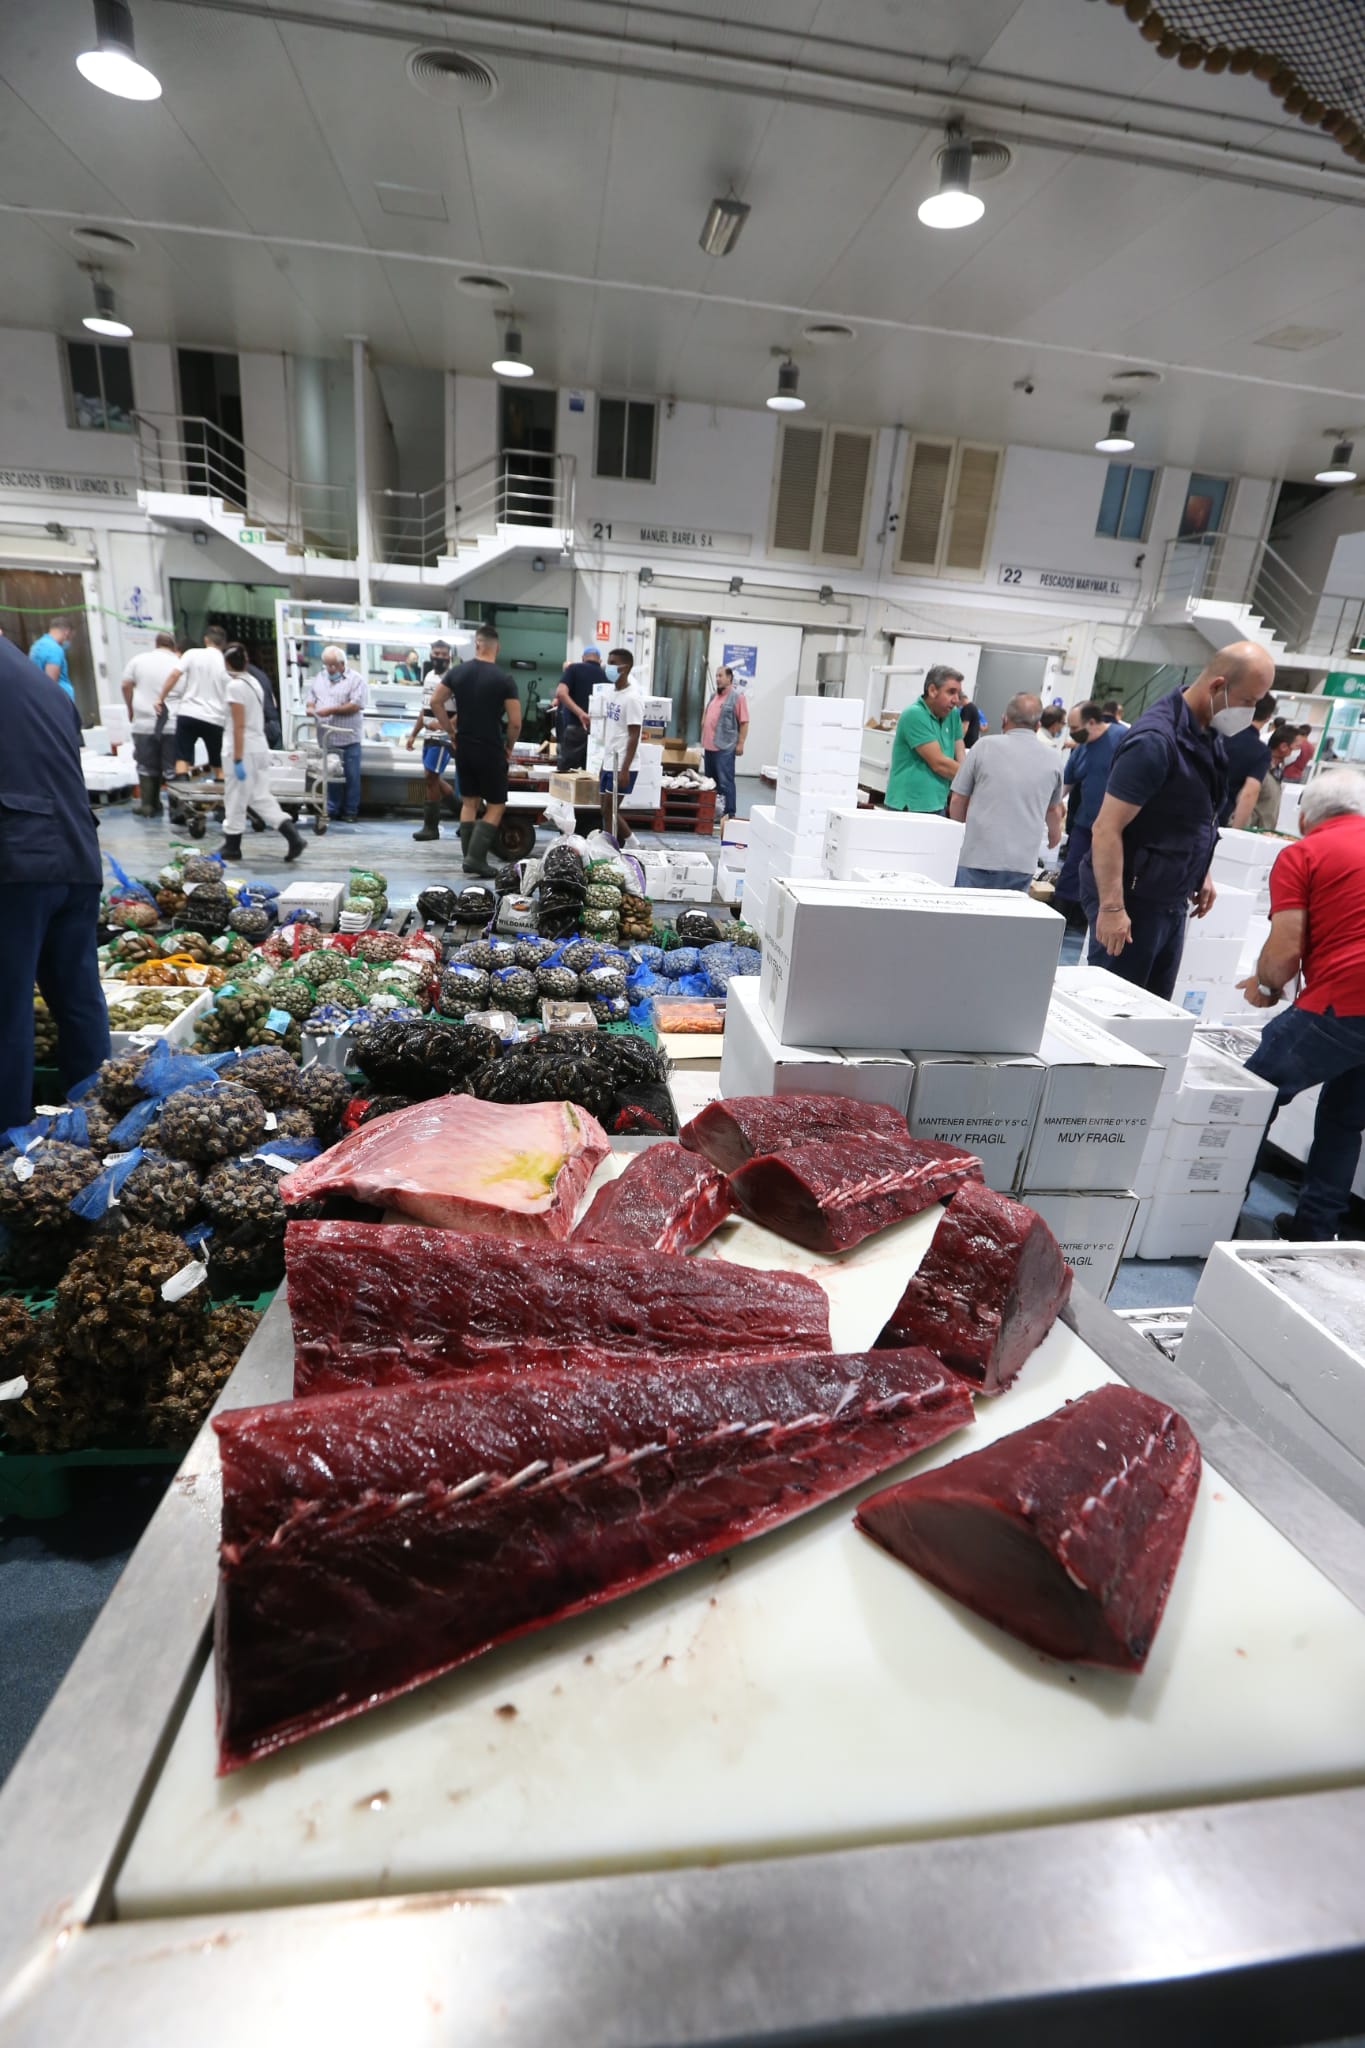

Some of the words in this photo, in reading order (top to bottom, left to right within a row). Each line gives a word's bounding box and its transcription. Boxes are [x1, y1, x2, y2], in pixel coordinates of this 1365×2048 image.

[593, 522, 612, 540] 21
[640, 528, 669, 543] MANUEL
[1003, 567, 1022, 584] 22
[1040, 573, 1075, 590] PESCADOS
[919, 1117, 964, 1126] MANTENER
[966, 1118, 993, 1127] ENTRE
[1005, 1119, 1011, 1127] Y
[1044, 1117, 1087, 1126] MANTENER
[1088, 1118, 1115, 1126] ENTRE
[934, 1133, 962, 1143] MUY
[964, 1133, 1007, 1144] FRAGIL
[1057, 1132, 1085, 1143] MUY
[1086, 1132, 1126, 1143] FRAGIL
[1064, 1256, 1093, 1266] RAGIL
